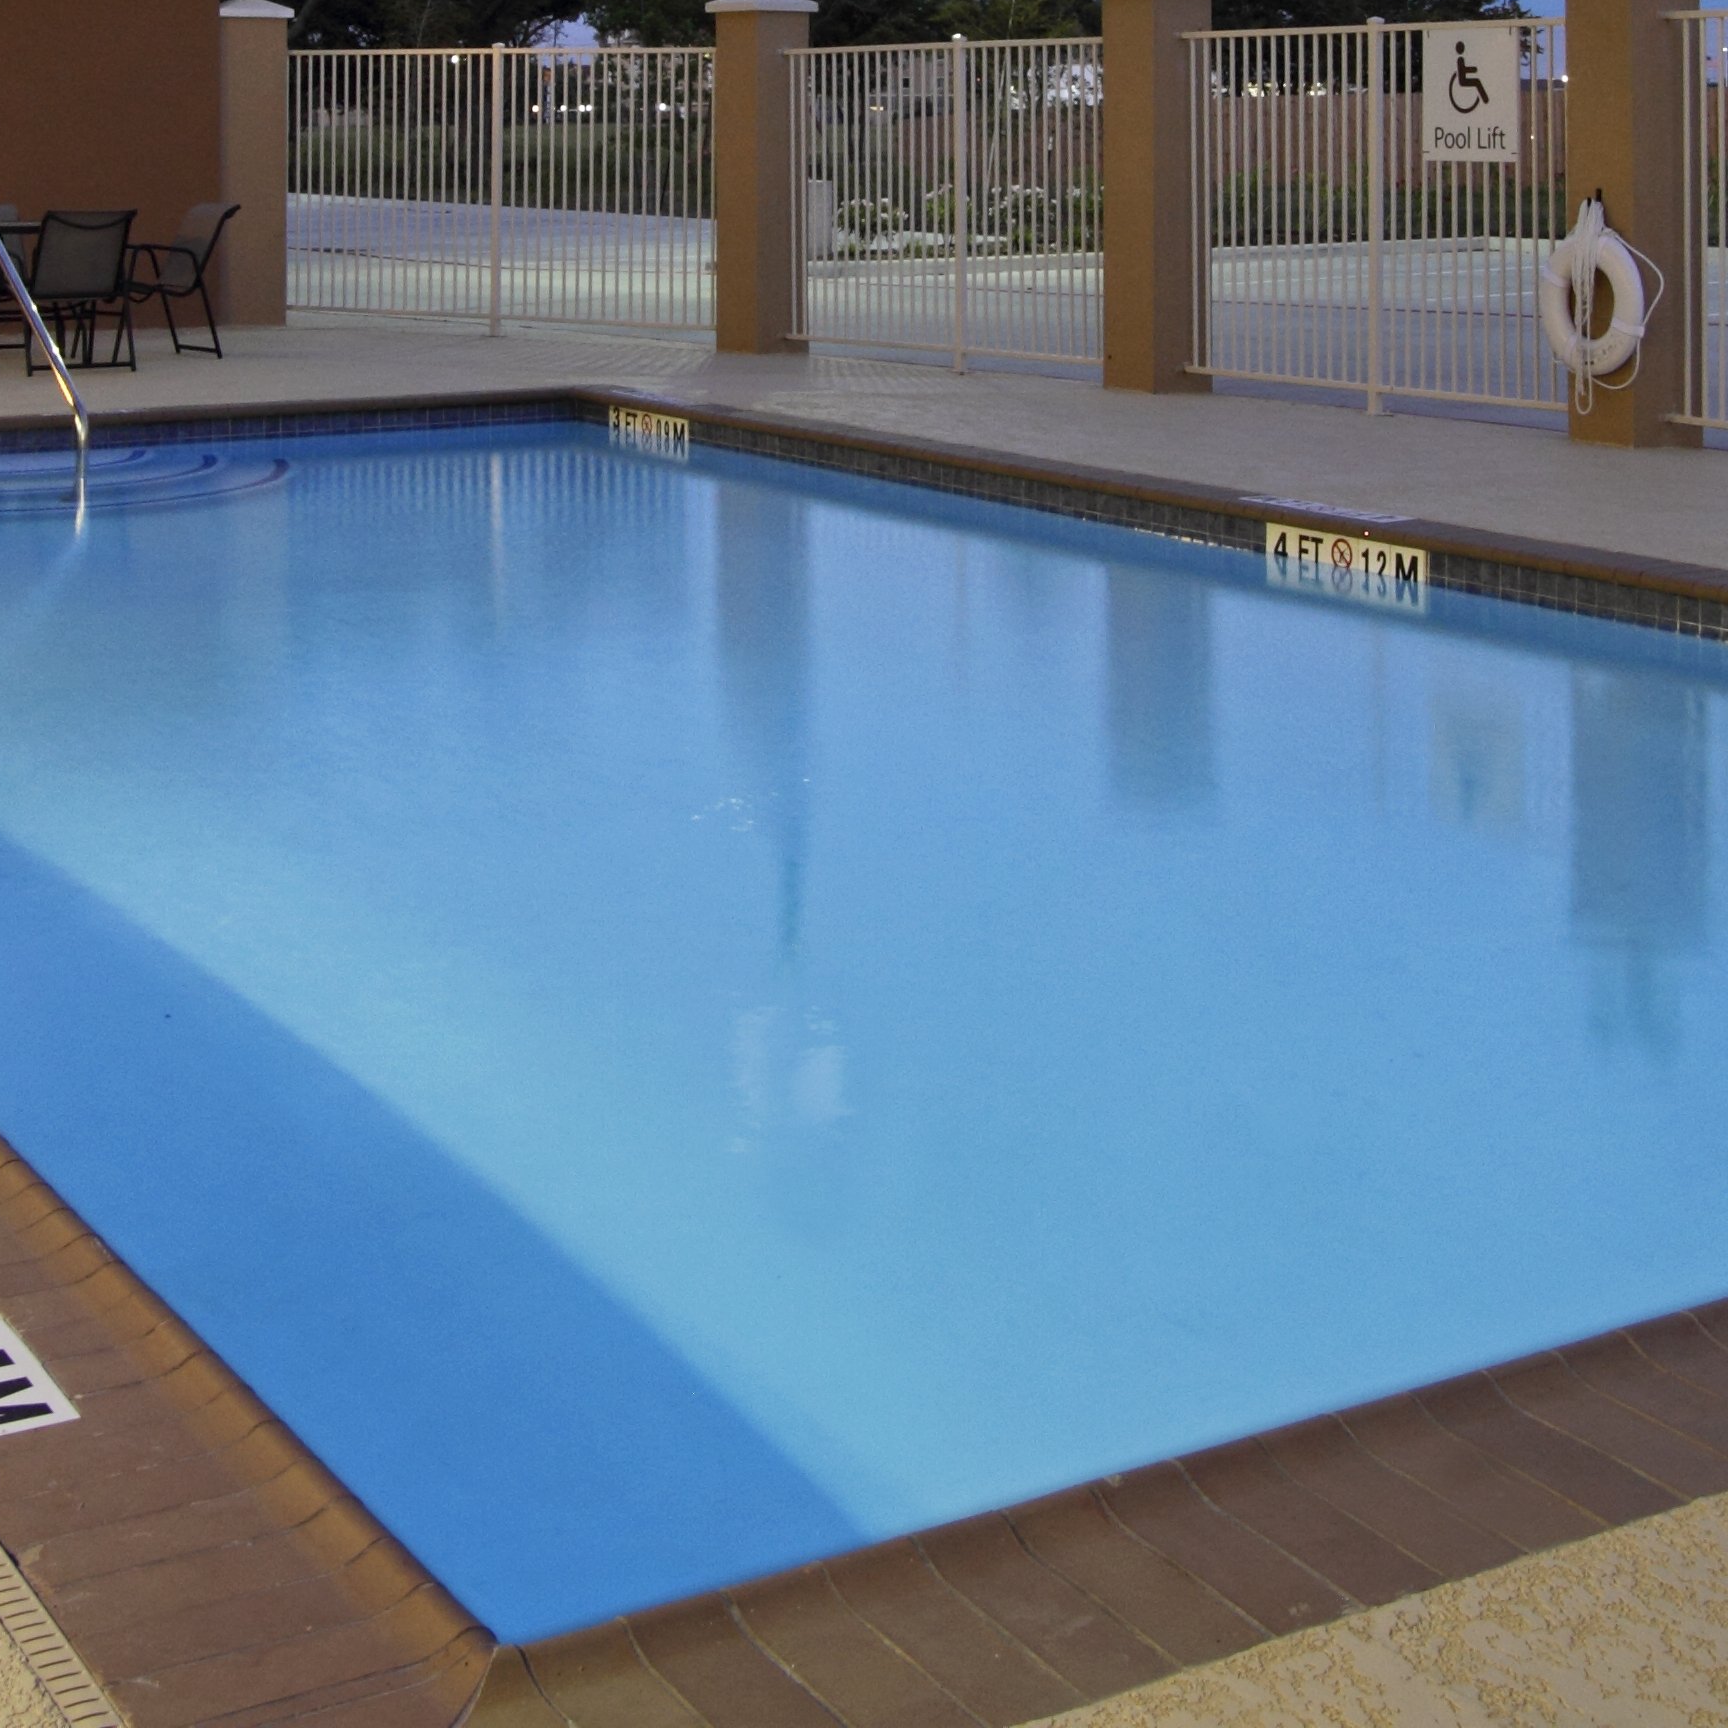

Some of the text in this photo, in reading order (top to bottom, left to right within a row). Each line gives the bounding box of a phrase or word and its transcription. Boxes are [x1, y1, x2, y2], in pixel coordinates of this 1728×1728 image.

[1435, 126, 1506, 149] Pool Lift
[612, 406, 620, 428] 3
[625, 412, 637, 433] FT
[1274, 532, 1288, 557] 4
[1298, 534, 1323, 564] FT
